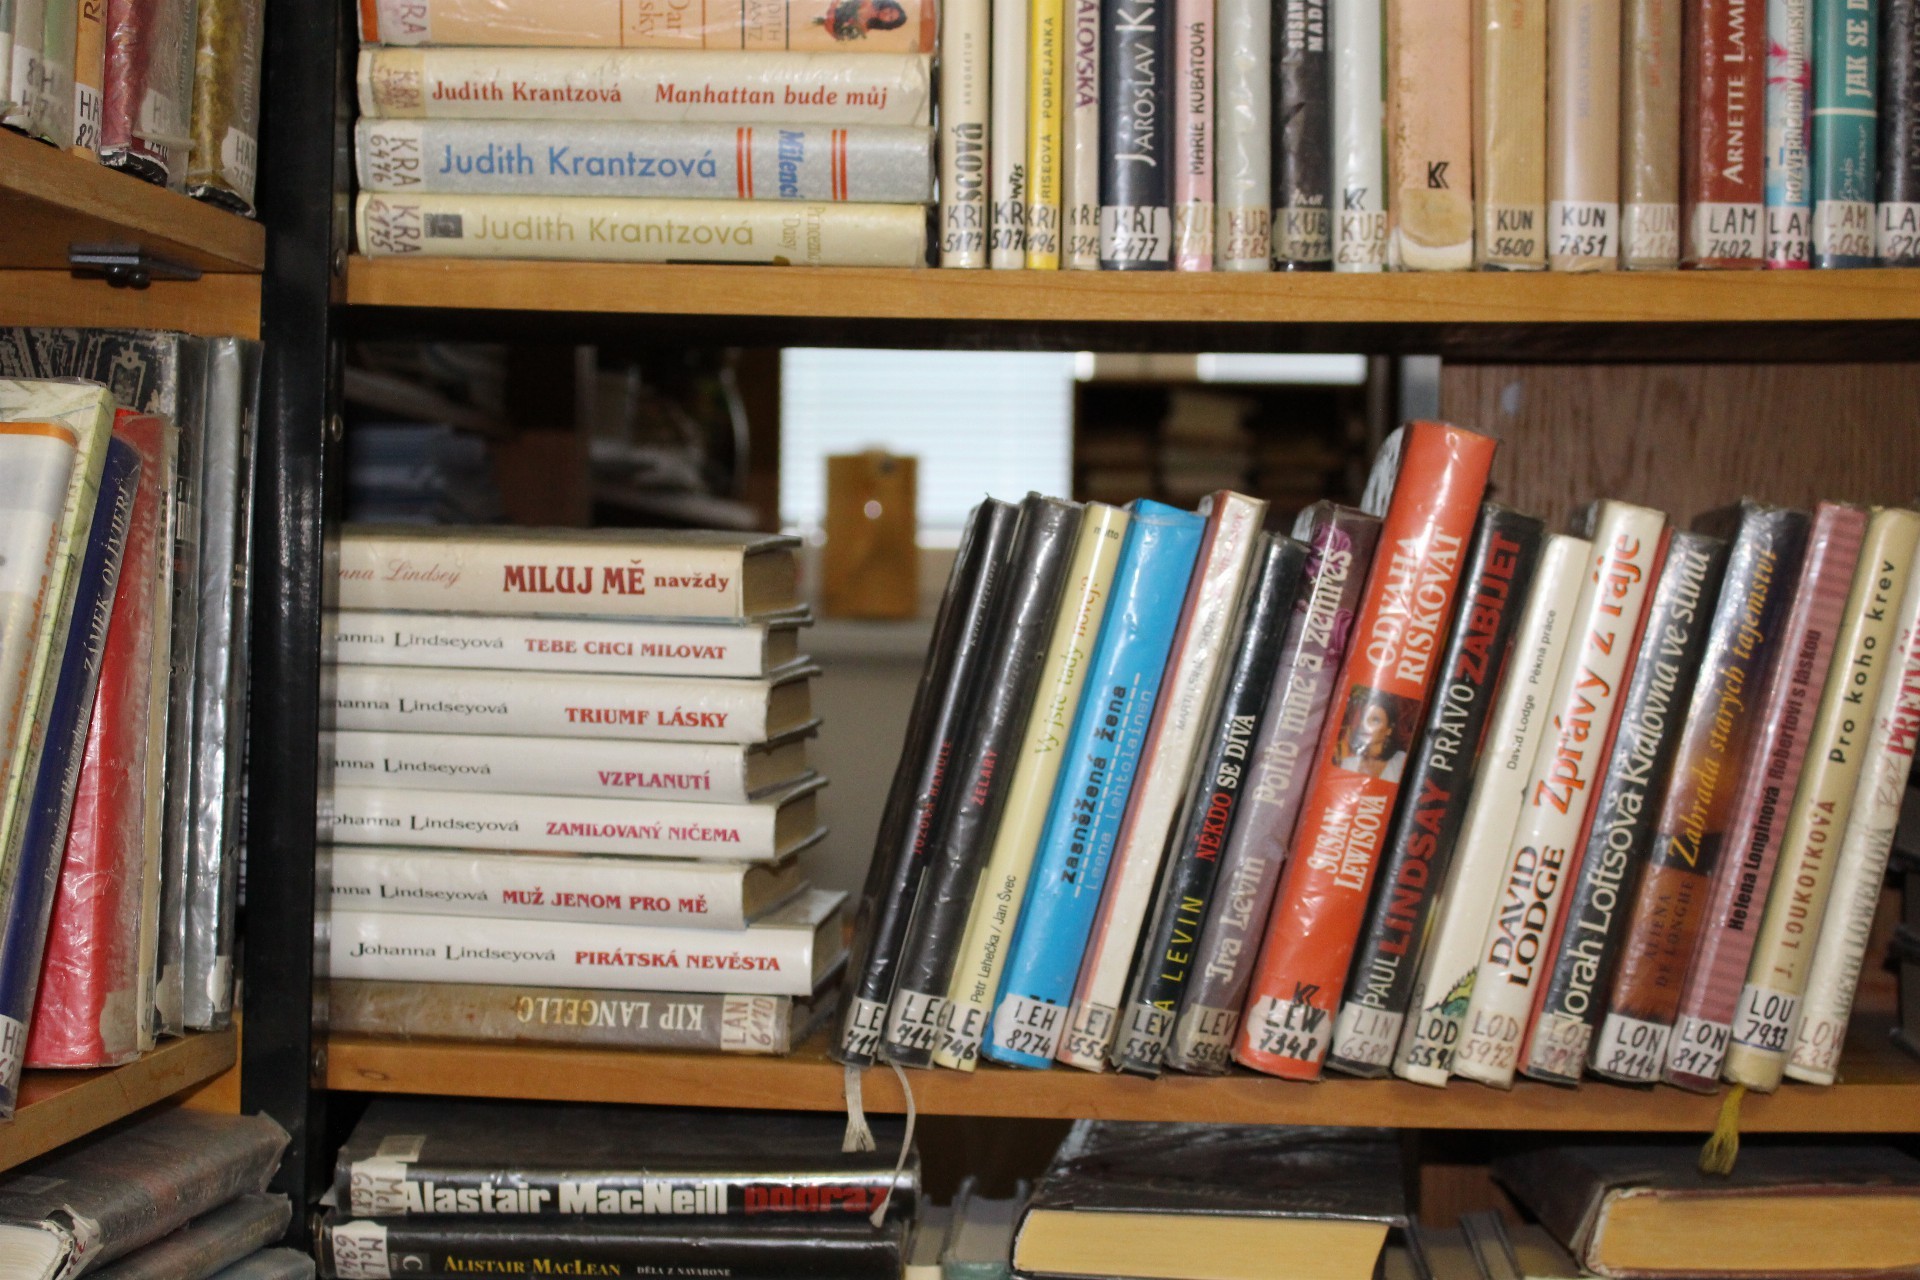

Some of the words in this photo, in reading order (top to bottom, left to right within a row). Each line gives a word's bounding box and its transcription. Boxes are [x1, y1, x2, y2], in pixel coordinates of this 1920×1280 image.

[1846, 19, 1869, 47] SE
[1042, 17, 1055, 118] POMPEJANKA
[1845, 55, 1872, 98] JAK
[432, 81, 503, 101] Judith
[512, 82, 622, 104] Krantzová
[655, 83, 774, 105] Manhattan
[784, 85, 837, 105] bude
[846, 86, 887, 110] můj
[1114, 45, 1157, 167] JAROSLAV
[1190, 119, 1204, 175] MARIE
[1722, 75, 1745, 185] ARNETTE
[390, 137, 421, 187] KRA
[439, 143, 535, 177] Judith
[548, 142, 718, 180] Krantzová
[392, 204, 421, 253] KRA
[473, 213, 575, 242] Judith
[590, 214, 754, 247] Krantzová
[948, 205, 983, 230] KRI
[1340, 214, 1385, 241] KUB
[1497, 209, 1533, 232] KUN
[1561, 206, 1606, 228] KUN
[1709, 206, 1757, 236] LAM
[1560, 235, 1608, 257] 7851
[381, 558, 461, 589] Lindsey
[503, 564, 593, 596] MILUJ
[602, 560, 646, 597] MĚ
[654, 573, 730, 594] navždy
[1593, 533, 1643, 618] ráje
[1304, 547, 1354, 649] zemřeš
[1365, 537, 1419, 669] ODVAHA
[1395, 524, 1463, 686] RISKOVAT
[84, 596, 110, 673] ZÁMEK
[394, 630, 504, 651] Lindseyová
[525, 638, 578, 656] TEBE
[584, 639, 634, 657] CHCI
[640, 642, 728, 661] MILOVAT
[1588, 631, 1616, 657] z
[1057, 646, 1084, 687] tady
[1299, 656, 1324, 674] a
[1827, 717, 1856, 765] Pro
[1843, 634, 1877, 705] koho
[1864, 559, 1896, 622] krev
[1505, 734, 1524, 771] David
[1521, 693, 1536, 734] Lodge
[1541, 609, 1558, 645] práce
[398, 697, 509, 718] Lindseyová
[565, 707, 651, 728] TRIUMF
[657, 705, 729, 730] LÁSKY
[1045, 694, 1068, 735] jste
[1708, 664, 1746, 753] starých
[1034, 725, 1060, 756] Vy
[1532, 666, 1611, 817] Zprávy
[383, 757, 492, 778] Lindseyová
[598, 768, 711, 792] VZPLANUTÍ
[1060, 752, 1108, 885] zasněžená
[1094, 685, 1127, 742] žena
[410, 813, 520, 834] Lindseyová
[1194, 792, 1233, 863] NĚKDO
[1216, 757, 1240, 790] SE
[1552, 938, 1606, 1028] Norah
[1662, 624, 1689, 658] ve
[1727, 866, 1759, 932] Helena
[1750, 785, 1781, 872] Longinová
[1767, 696, 1805, 782] Robertovi
[546, 818, 663, 842] ZAMILOVANÝ
[668, 821, 742, 845] NIČEMA
[1306, 806, 1354, 876] SUSAN
[1085, 832, 1112, 891] Leena
[1378, 779, 1451, 958] LINDSAY
[379, 884, 489, 904] Lindseyová
[502, 886, 544, 906] MUŽ
[550, 891, 622, 912] JENOM
[629, 895, 671, 914] PRO
[678, 892, 709, 916] MĚ
[1000, 874, 1018, 902] Švec
[1219, 856, 1266, 932] Levin
[992, 902, 1008, 927] Jan
[1487, 844, 1539, 970] DAVID
[1508, 844, 1565, 989] LODGE
[350, 942, 436, 960] Johanna
[445, 944, 556, 966] Lindseyová
[977, 934, 1001, 979] Lehečka
[1161, 896, 1204, 983] LEVIN
[575, 945, 679, 970] PIRÁTSKÁ
[686, 948, 781, 973] NEVĚSTA
[970, 979, 987, 1005] Petr
[1361, 952, 1400, 1011] PAUL
[658, 1003, 705, 1032] KIP
[722, 1001, 749, 1044] LAN
[1013, 1001, 1057, 1031] LEH
[1353, 1008, 1396, 1039] LIN
[1750, 990, 1795, 1023] LOU
[1415, 1016, 1459, 1045] LOD
[1616, 1021, 1665, 1053] LON
[1682, 1021, 1728, 1052] LON
[402, 1180, 551, 1214] Alastair
[558, 1183, 728, 1216] MacNeill
